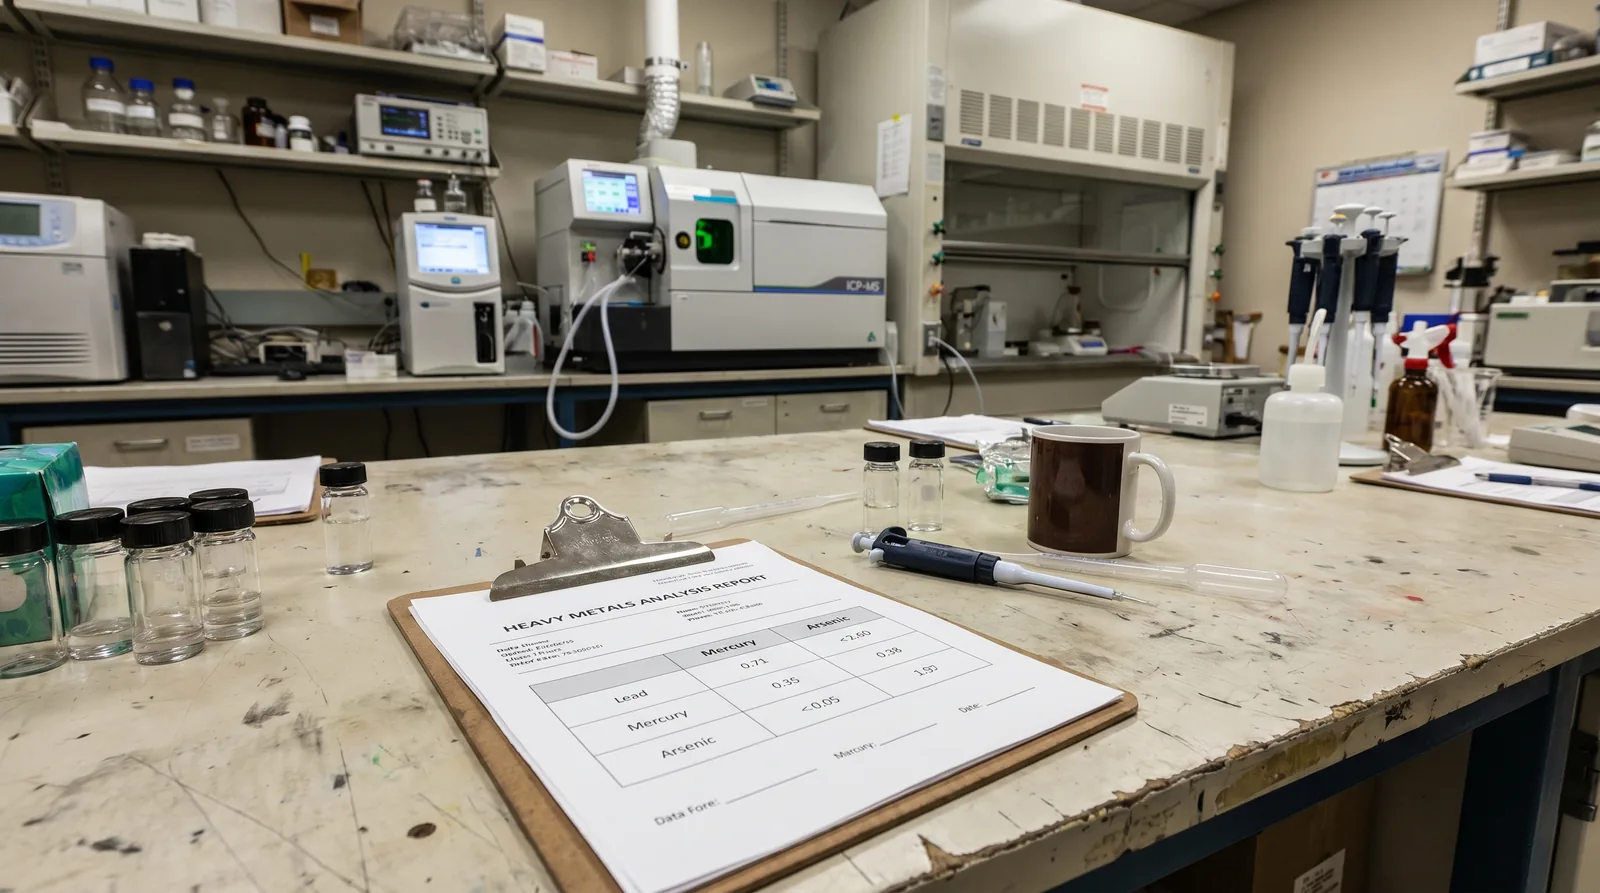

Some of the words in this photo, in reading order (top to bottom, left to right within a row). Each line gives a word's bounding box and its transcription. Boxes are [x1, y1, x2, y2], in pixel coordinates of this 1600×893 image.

[847, 280, 880, 292] ICP-MS
[503, 614, 564, 632] HEAVY
[568, 600, 636, 620] METALS
[639, 584, 712, 606] ANALYSIS
[711, 574, 768, 591] REPORT
[614, 689, 649, 704] Lead
[740, 657, 770, 670] 0.71
[840, 629, 872, 643] <2.60
[700, 638, 757, 657] Mercury
[806, 614, 850, 631] Arsenic
[627, 709, 688, 732] Mercury
[771, 676, 800, 689] 0.35
[875, 646, 903, 659] 0.38
[661, 736, 717, 759] Arsenic
[801, 695, 841, 713] <0.05
[653, 810, 686, 827] Data
[687, 798, 720, 815] Fore:
[957, 702, 983, 714] Date:
